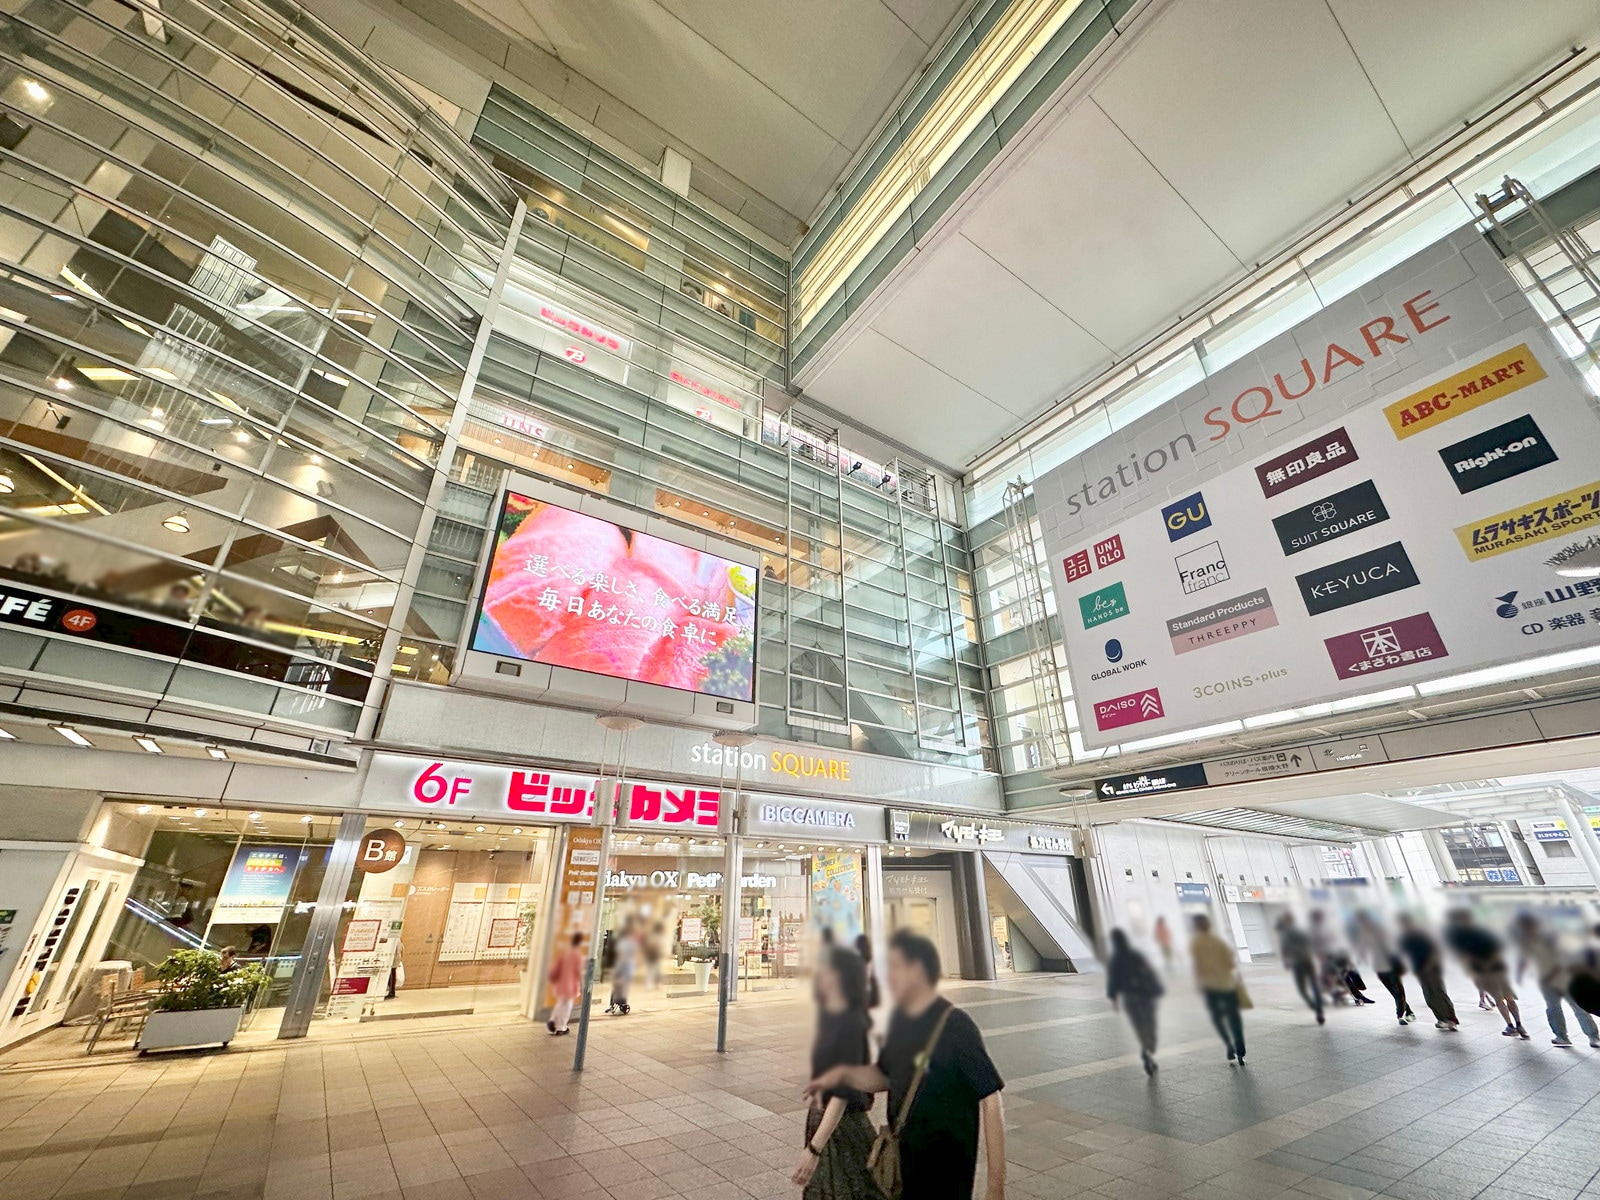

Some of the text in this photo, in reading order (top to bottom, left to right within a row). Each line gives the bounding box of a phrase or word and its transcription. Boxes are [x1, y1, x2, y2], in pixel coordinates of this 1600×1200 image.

[1066, 289, 1451, 516] station SQUARE
[1399, 359, 1526, 428] ABC-MART
[1265, 441, 1347, 486] 無印良品
[1167, 502, 1206, 530] GU
[1290, 509, 1377, 549] SUIT SQUARE
[1474, 526, 1549, 554] MURASAKI
[1096, 538, 1117, 556] UNI
[1099, 549, 1122, 567] QLO
[1180, 559, 1226, 583] Franc
[1187, 571, 1226, 593] franc
[1310, 562, 1401, 599] KEYUCA
[537, 586, 717, 646] 毎日あなたの食卓に
[1087, 606, 1124, 624] HANDS be
[1171, 596, 1265, 632] Standard Products
[1521, 598, 1547, 610] 銀座
[68, 615, 93, 627] 4F
[1188, 618, 1257, 645] THREEPPY
[1521, 622, 1544, 636] CD
[1547, 612, 1586, 631] 楽器
[1090, 658, 1148, 682] GLOBAL WORK
[1099, 698, 1136, 715] DAISO
[690, 743, 851, 782] station SQUARE
[414, 762, 473, 805] 6F
[761, 804, 857, 828] BICCAMERA
[363, 838, 398, 862] B館
[650, 870, 680, 888] OX
